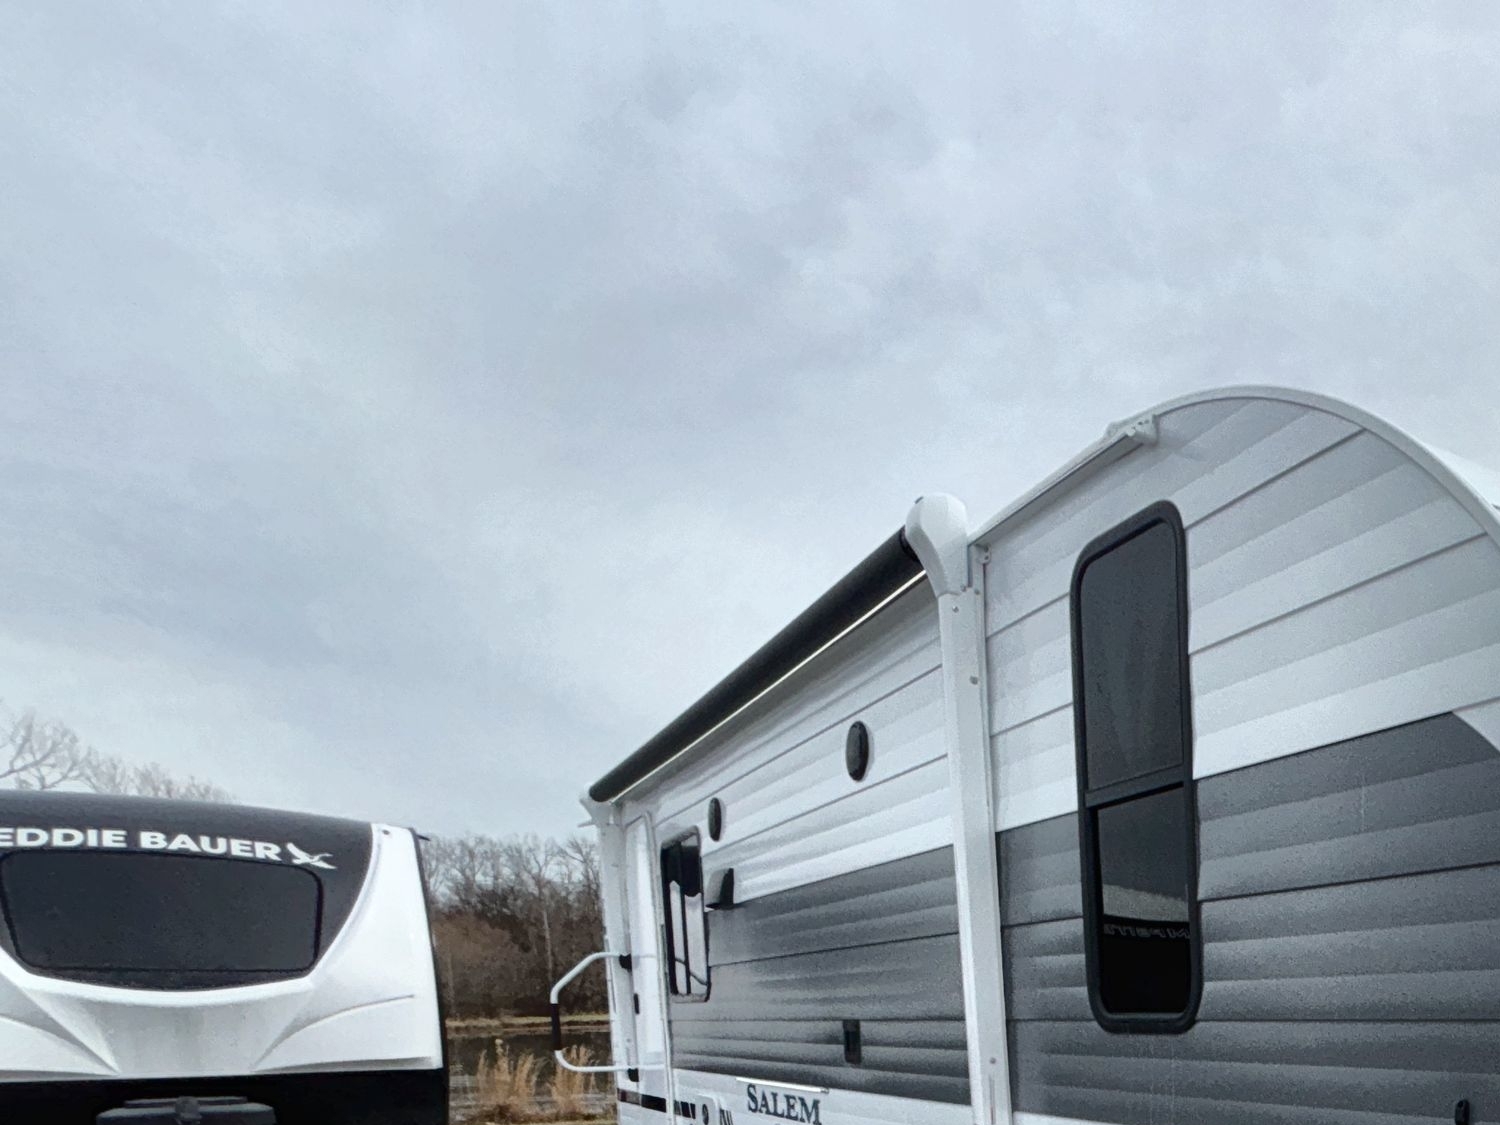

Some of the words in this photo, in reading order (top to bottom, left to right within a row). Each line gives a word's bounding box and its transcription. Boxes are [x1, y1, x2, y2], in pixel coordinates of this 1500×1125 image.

[0, 827, 127, 848] EDDIE
[140, 831, 282, 861] BAUER
[747, 1083, 822, 1125] SALEM
